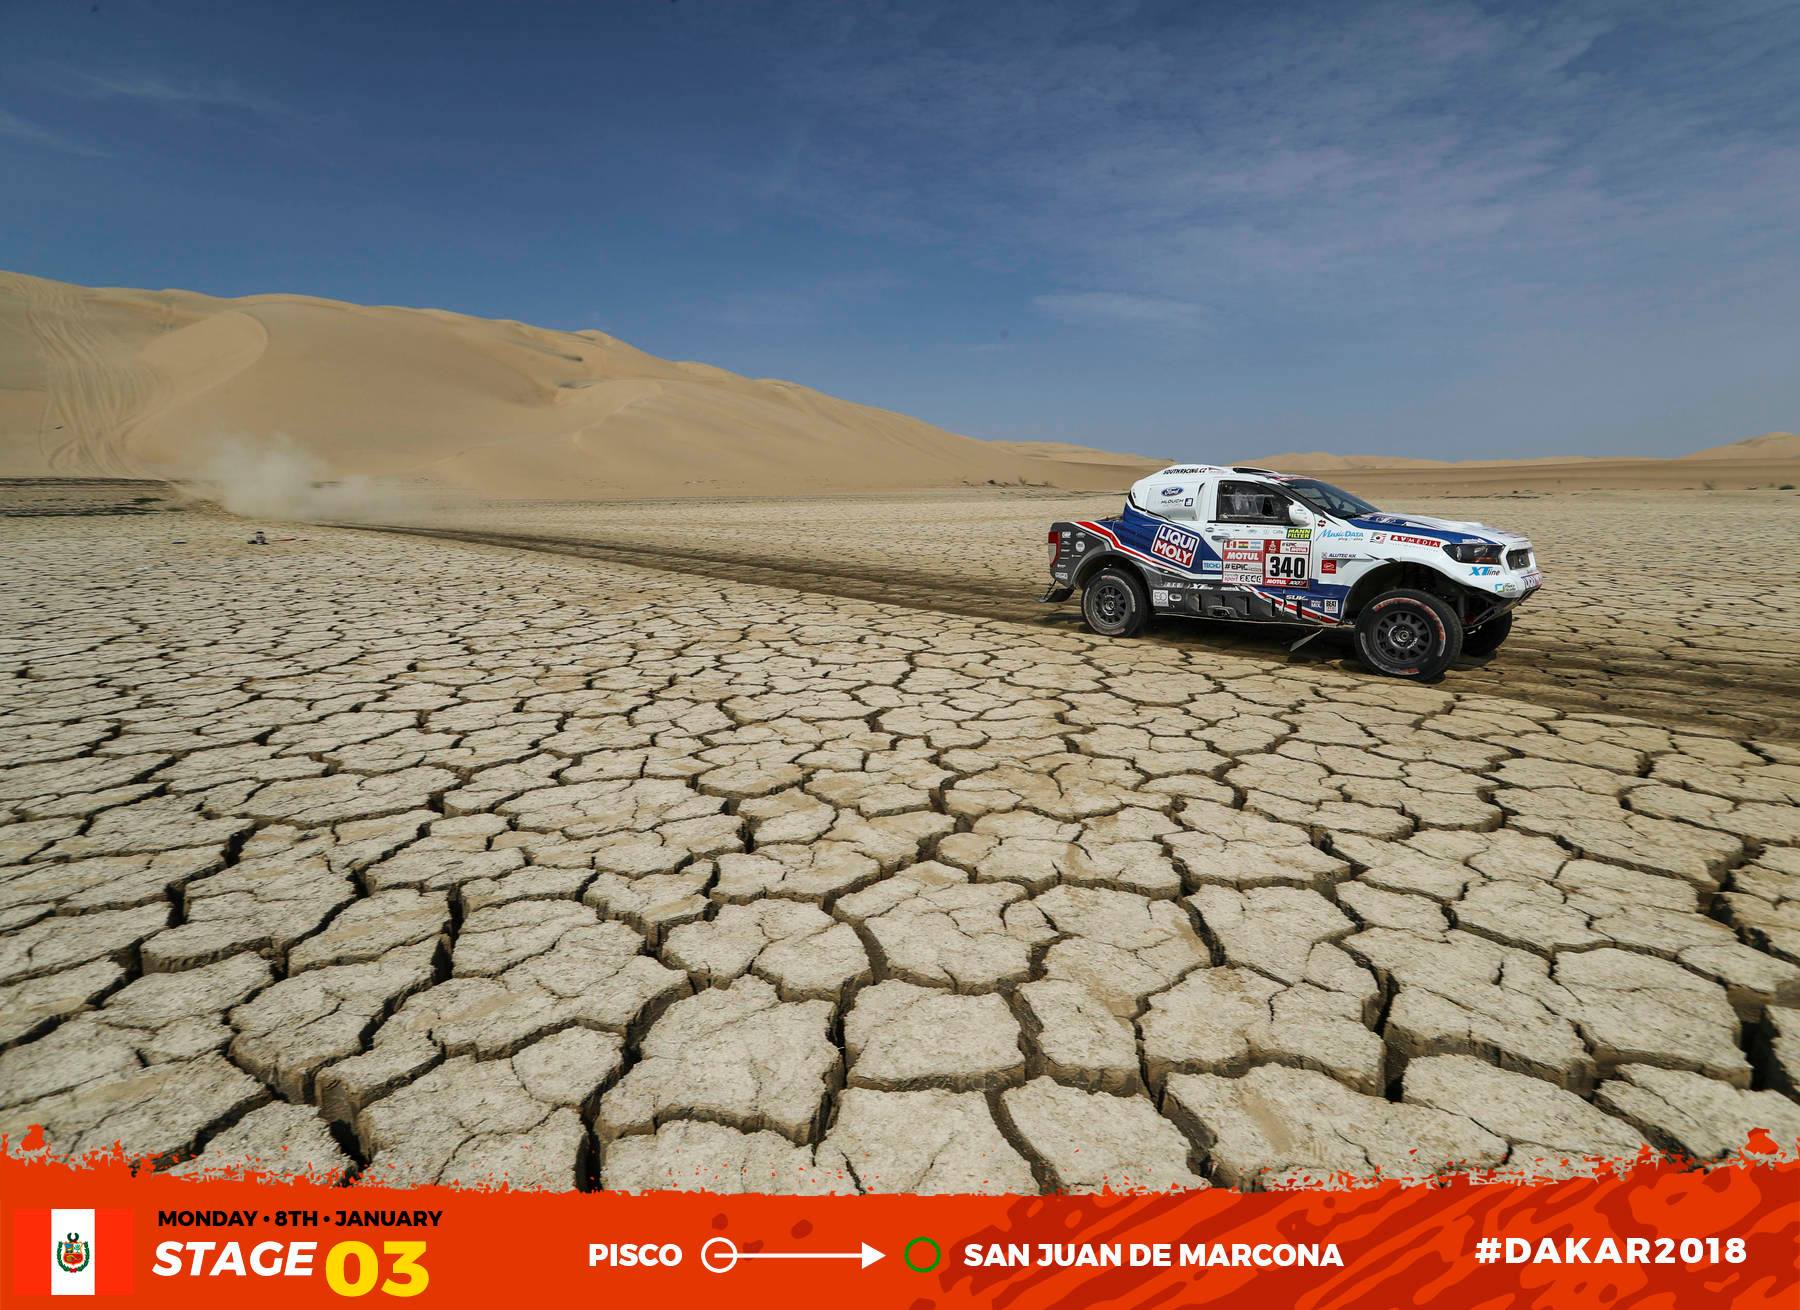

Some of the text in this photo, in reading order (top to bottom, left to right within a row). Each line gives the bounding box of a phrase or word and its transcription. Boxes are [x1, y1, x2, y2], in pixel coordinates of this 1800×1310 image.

[1158, 527, 1196, 551] LIQUI
[1154, 540, 1192, 564] MOLY
[1227, 552, 1260, 561] MOTUL
[1270, 556, 1306, 578] 340
[1469, 566, 1501, 576] XTline
